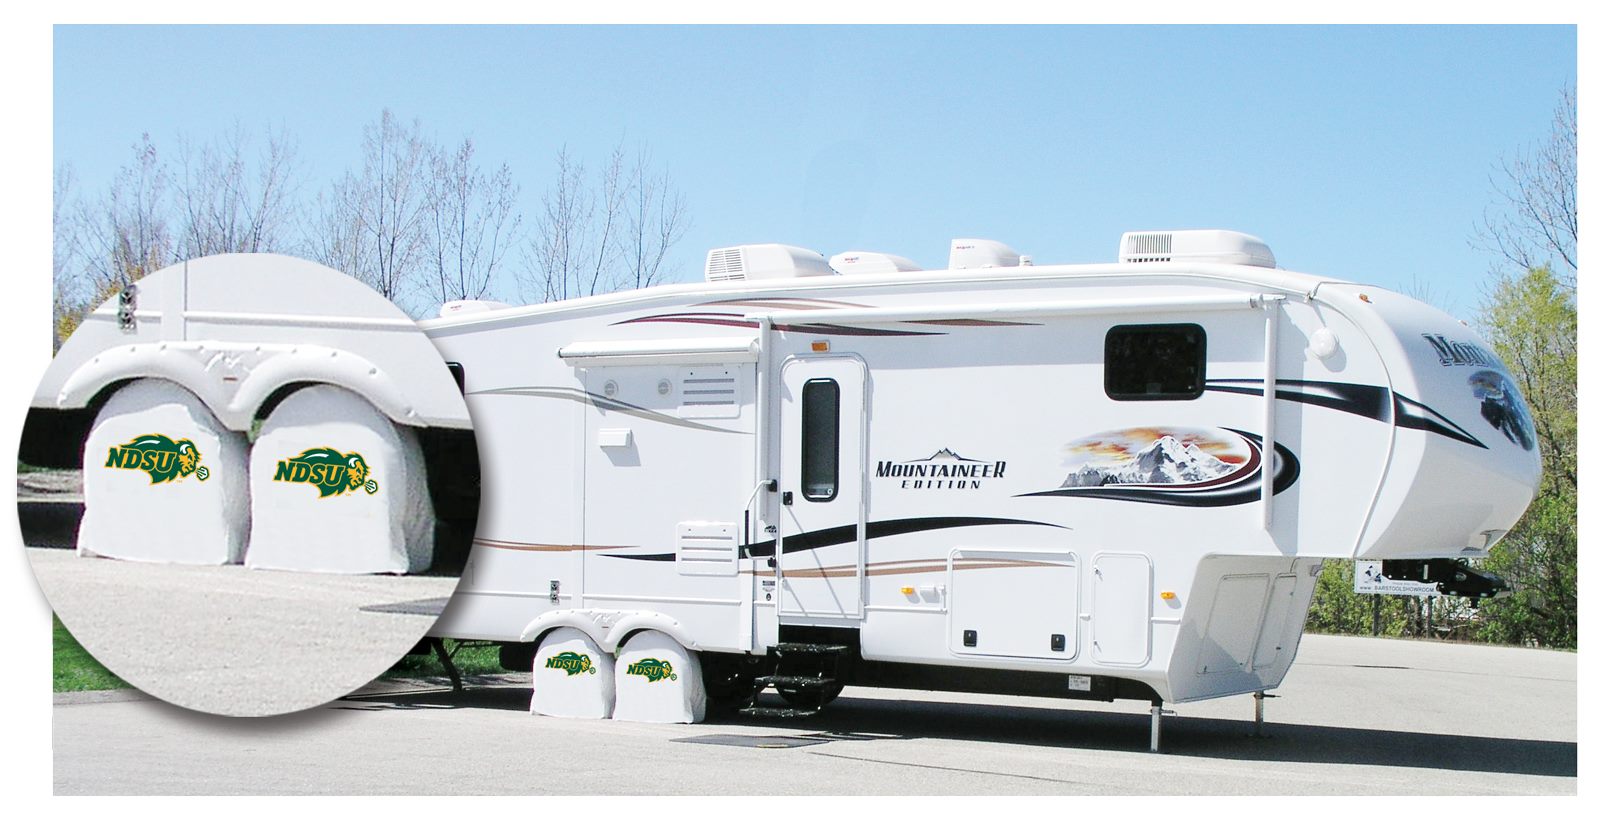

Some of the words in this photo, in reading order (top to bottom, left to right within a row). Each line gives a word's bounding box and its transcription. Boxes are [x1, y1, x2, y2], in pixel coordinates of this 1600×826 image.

[104, 447, 177, 474] NDSU
[272, 460, 346, 487] NDSU
[876, 461, 1006, 478] MOUNTAINEER
[901, 480, 981, 489] EDITION
[545, 657, 580, 671] NDSU
[626, 664, 661, 677] NDSU
